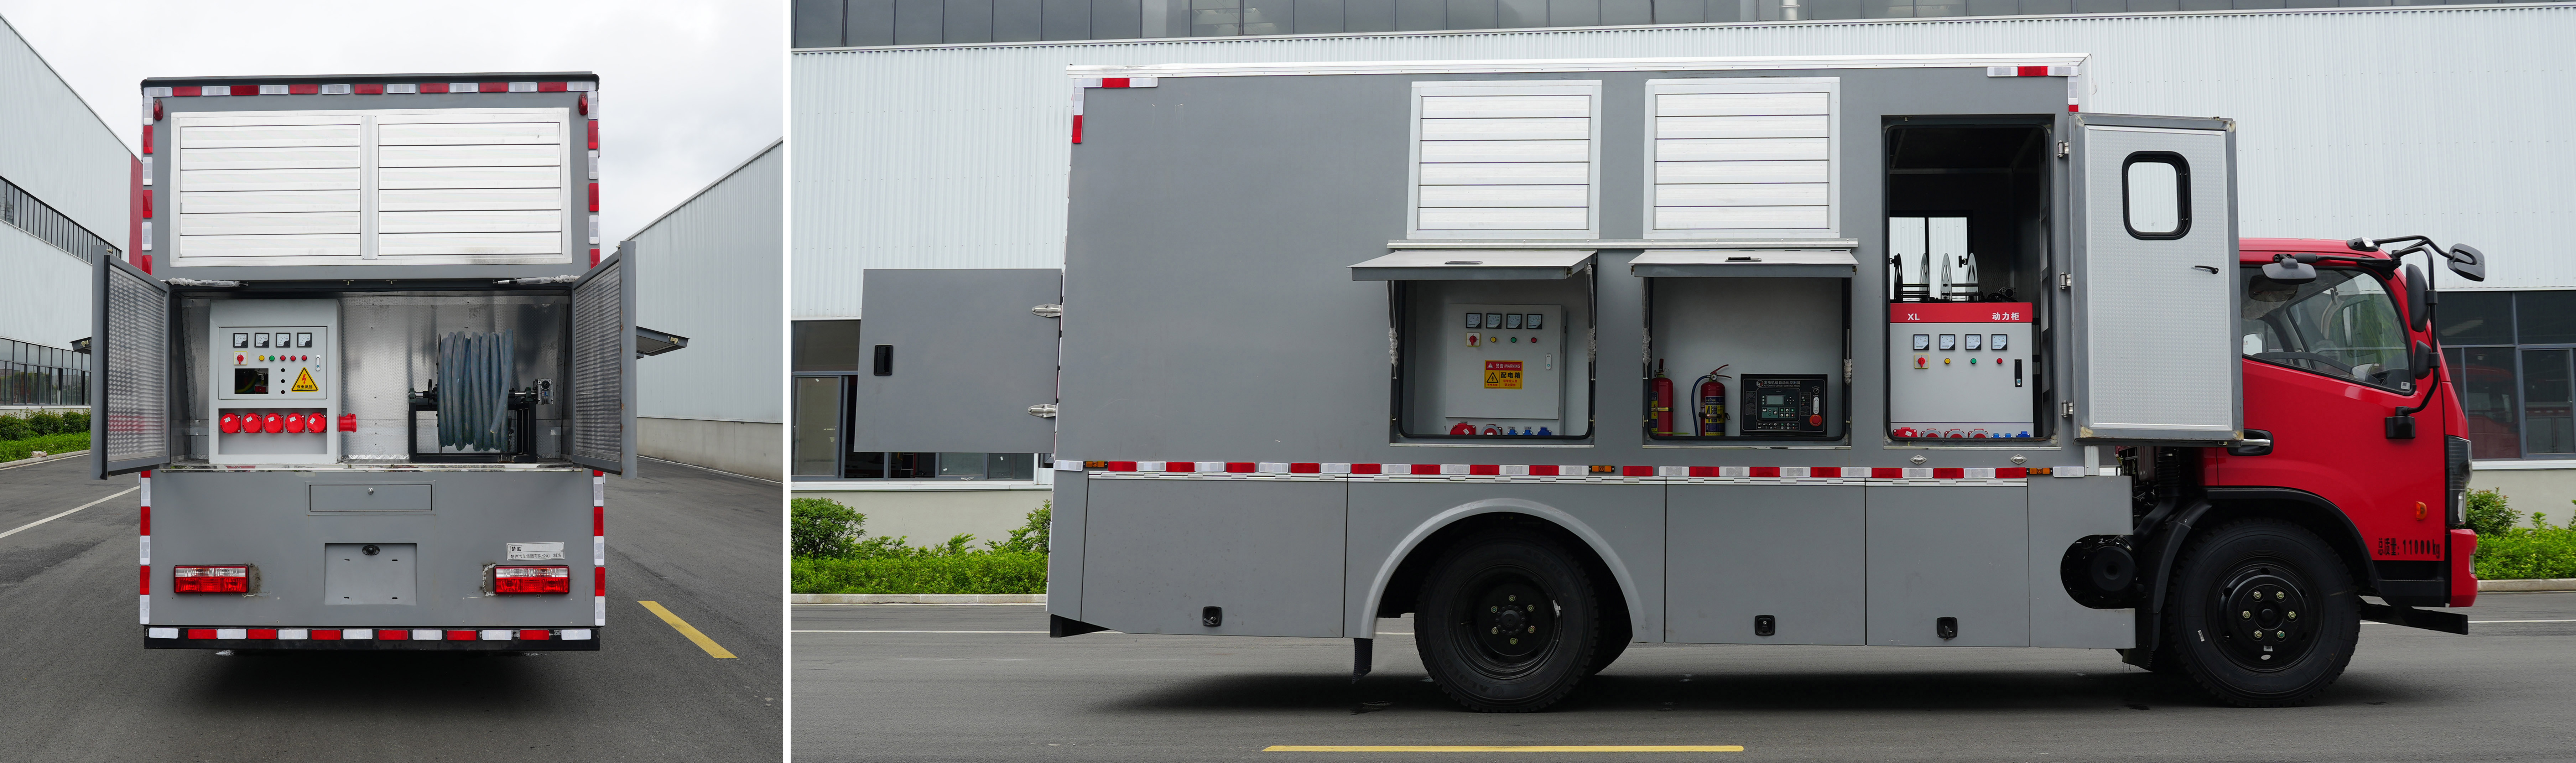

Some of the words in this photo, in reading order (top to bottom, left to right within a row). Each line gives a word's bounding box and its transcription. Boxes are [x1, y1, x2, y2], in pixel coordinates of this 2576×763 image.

[1992, 312, 2020, 320] 动力柜
[2403, 539, 2441, 559] 11000kg
